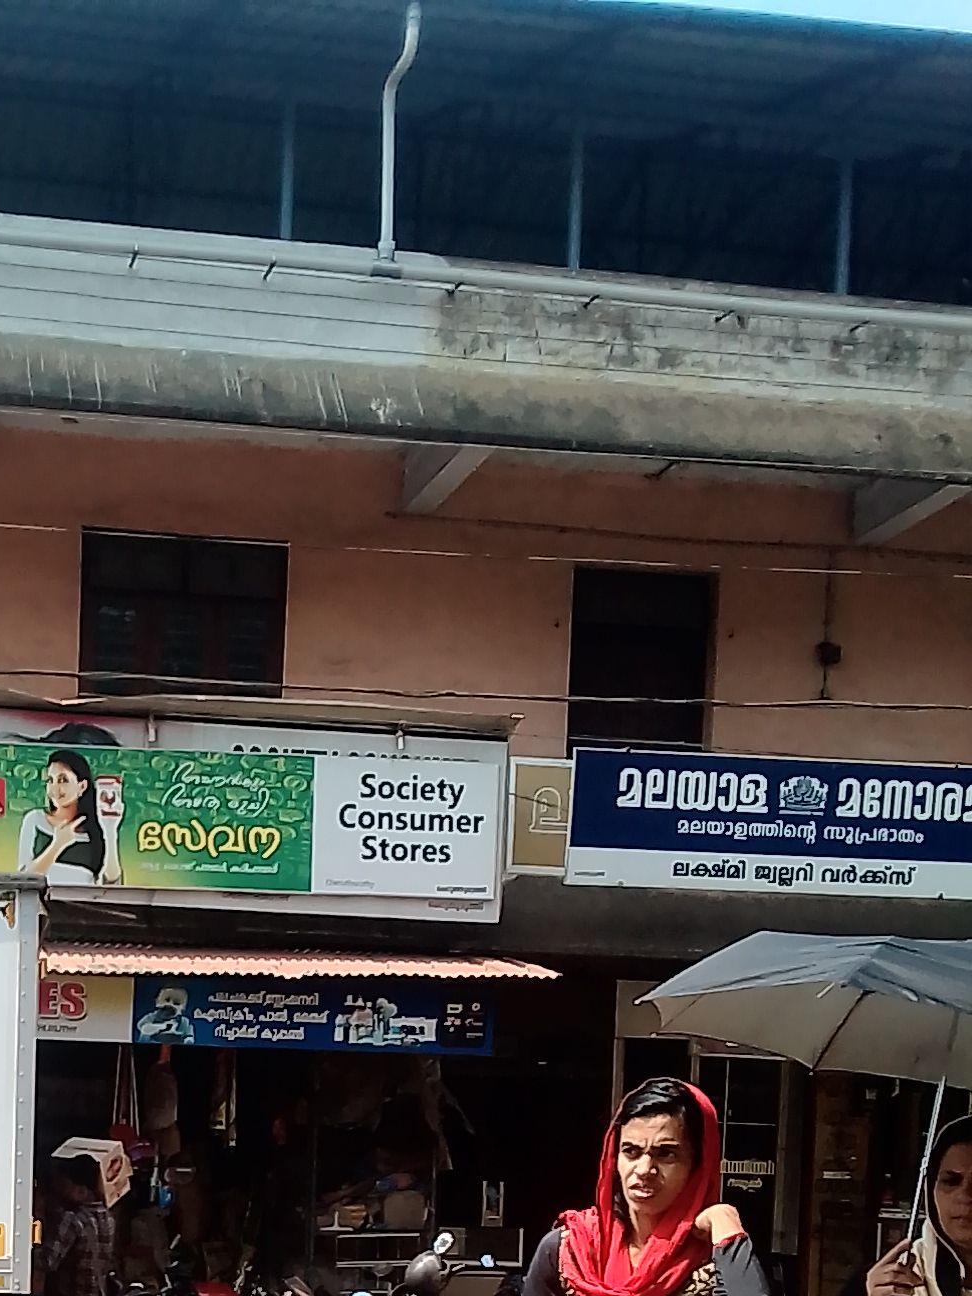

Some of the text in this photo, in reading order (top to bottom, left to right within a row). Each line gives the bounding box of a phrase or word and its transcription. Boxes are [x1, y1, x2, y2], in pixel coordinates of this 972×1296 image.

[360, 773, 464, 809] Society
[616, 767, 768, 813] മലയാള
[339, 803, 484, 833] Consumer
[677, 819, 924, 845] മലയാളത്തിന്റെ സുപ്രഭാതം
[137, 819, 281, 859] സേവന
[361, 835, 451, 863] Stores
[754, 863, 813, 886] ജ്വല്ലറി
